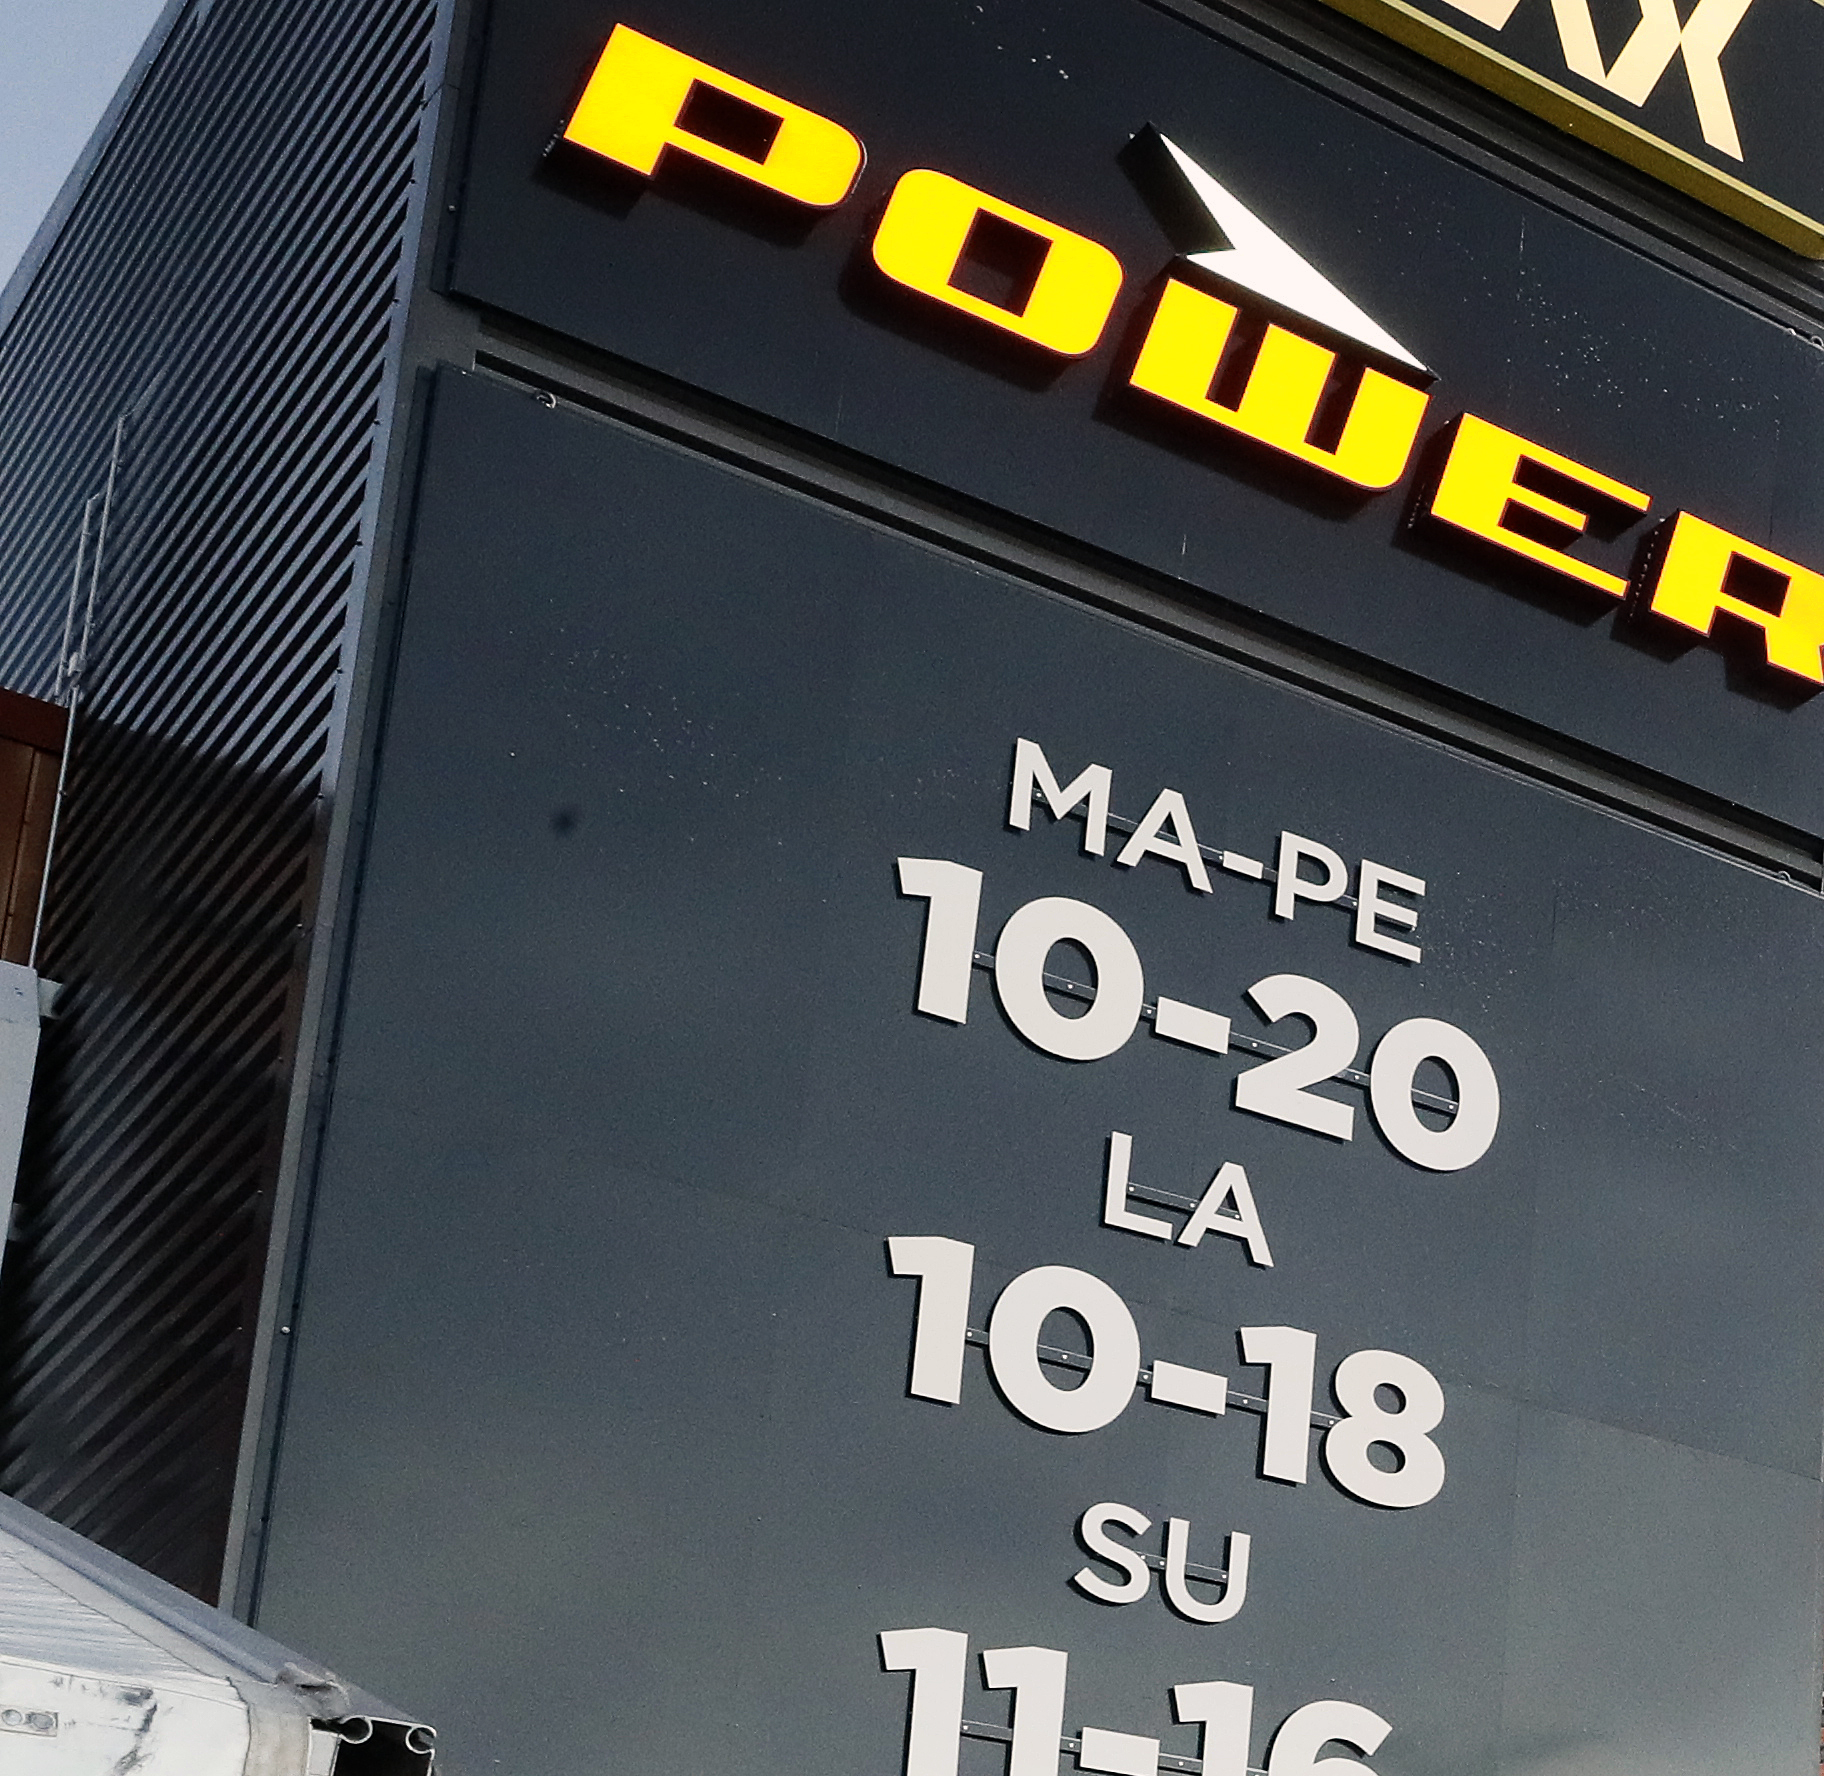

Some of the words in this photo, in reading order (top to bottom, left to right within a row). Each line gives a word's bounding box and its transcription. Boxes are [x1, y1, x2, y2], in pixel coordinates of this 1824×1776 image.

[1008, 737, 1426, 963] MA-PE
[897, 857, 1500, 1172] 10-20
[1105, 1131, 1275, 1269] LA
[887, 1235, 1446, 1508] 10-18
[1072, 1502, 1250, 1623] SU
